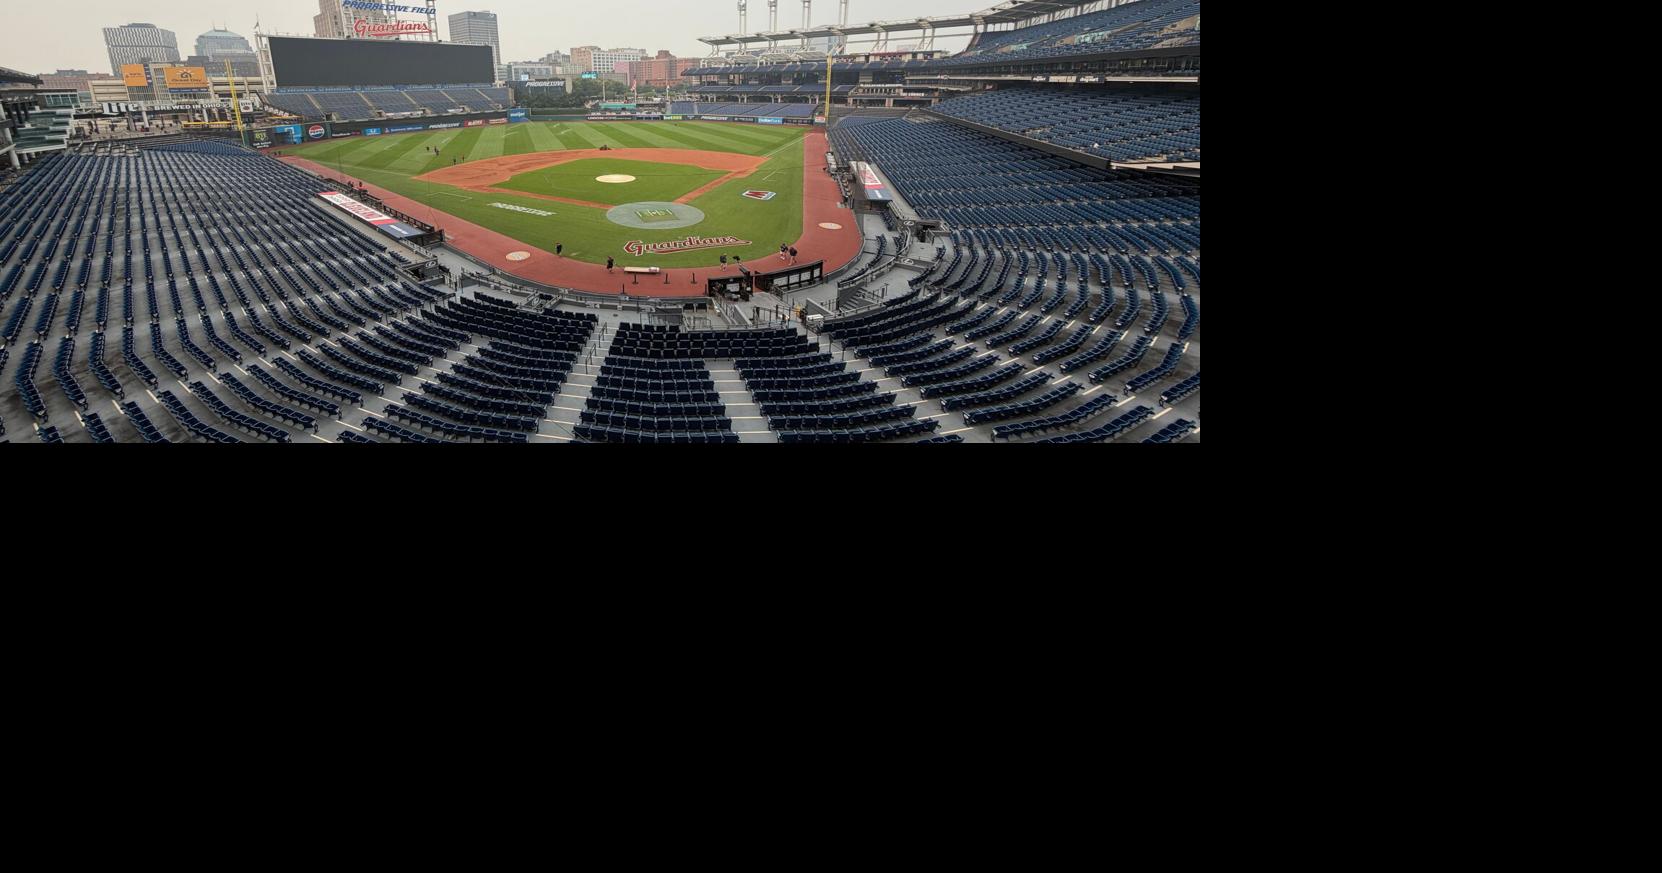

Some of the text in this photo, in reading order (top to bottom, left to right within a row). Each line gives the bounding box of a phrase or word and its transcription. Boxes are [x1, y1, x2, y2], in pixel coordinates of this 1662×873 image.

[342, 0, 436, 15] PROGRESSIVE FIELD
[353, 16, 433, 37] Guardians
[623, 236, 752, 257] Guardians
